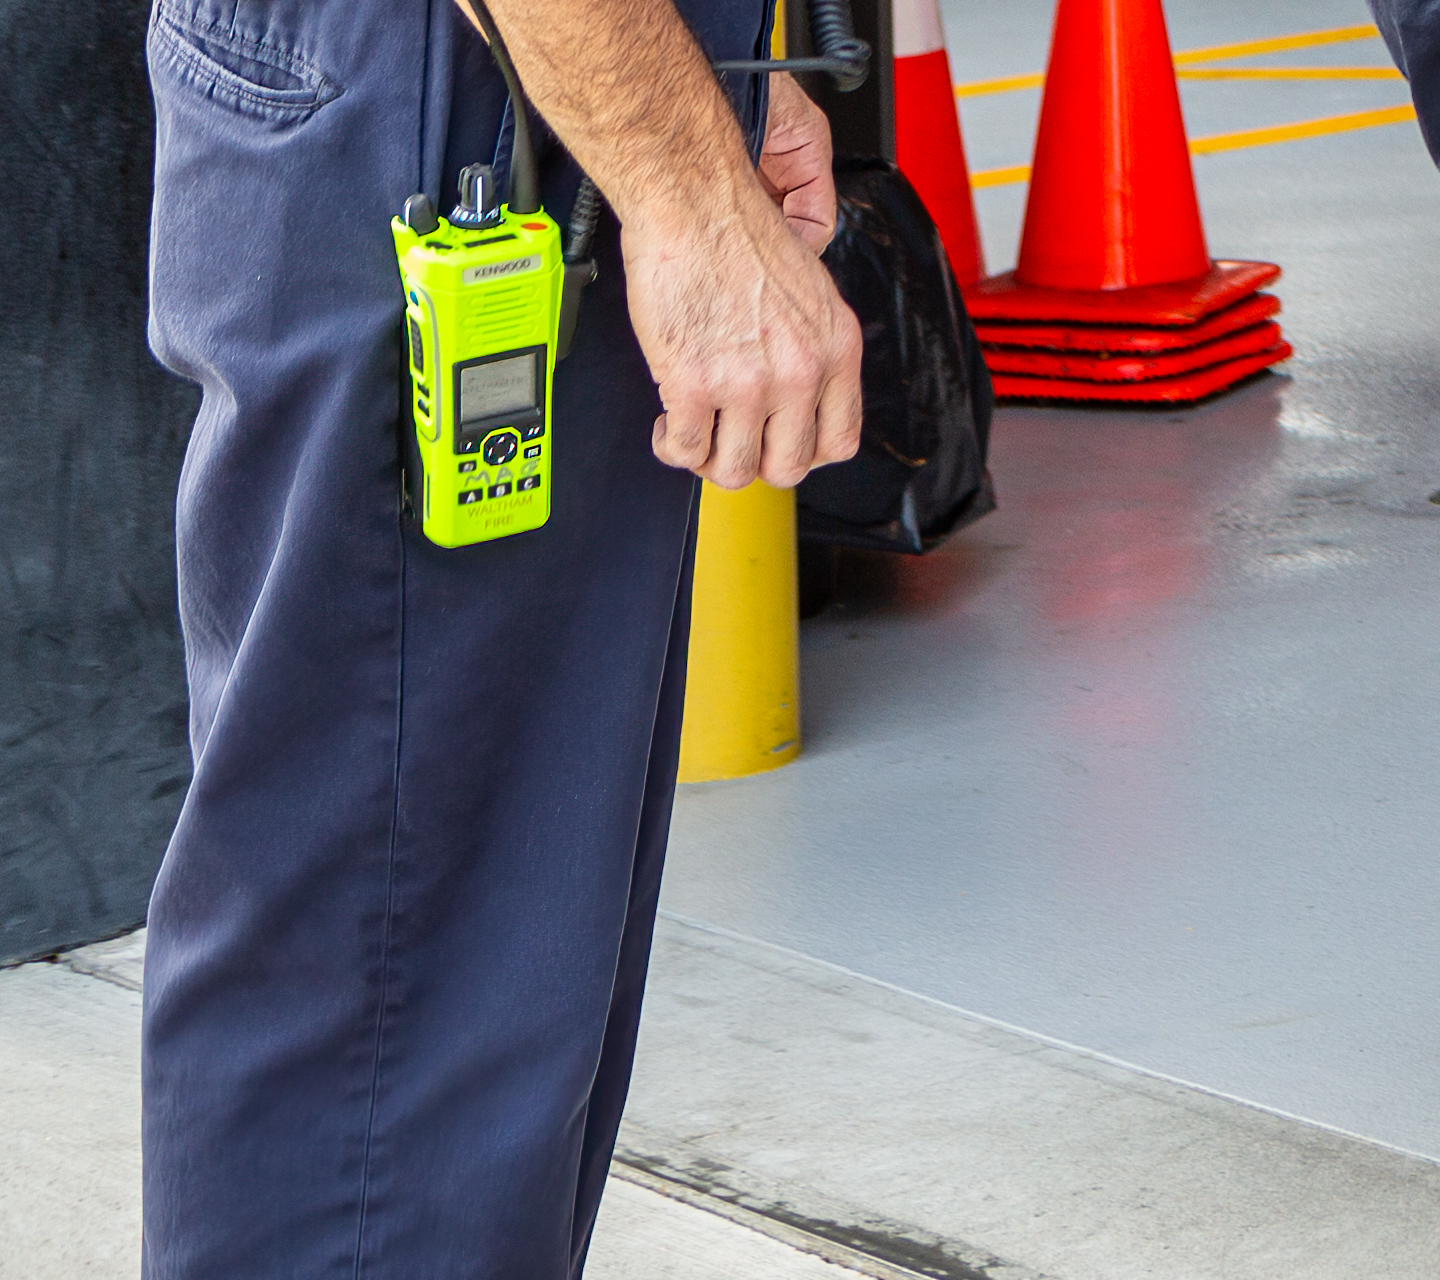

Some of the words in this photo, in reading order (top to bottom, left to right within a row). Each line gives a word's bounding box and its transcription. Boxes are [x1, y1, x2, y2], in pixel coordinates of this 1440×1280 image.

[474, 258, 532, 279] KENWOOD
[523, 477, 534, 491] C
[467, 493, 534, 519] WALTHAM
[485, 513, 514, 531] FIRE
